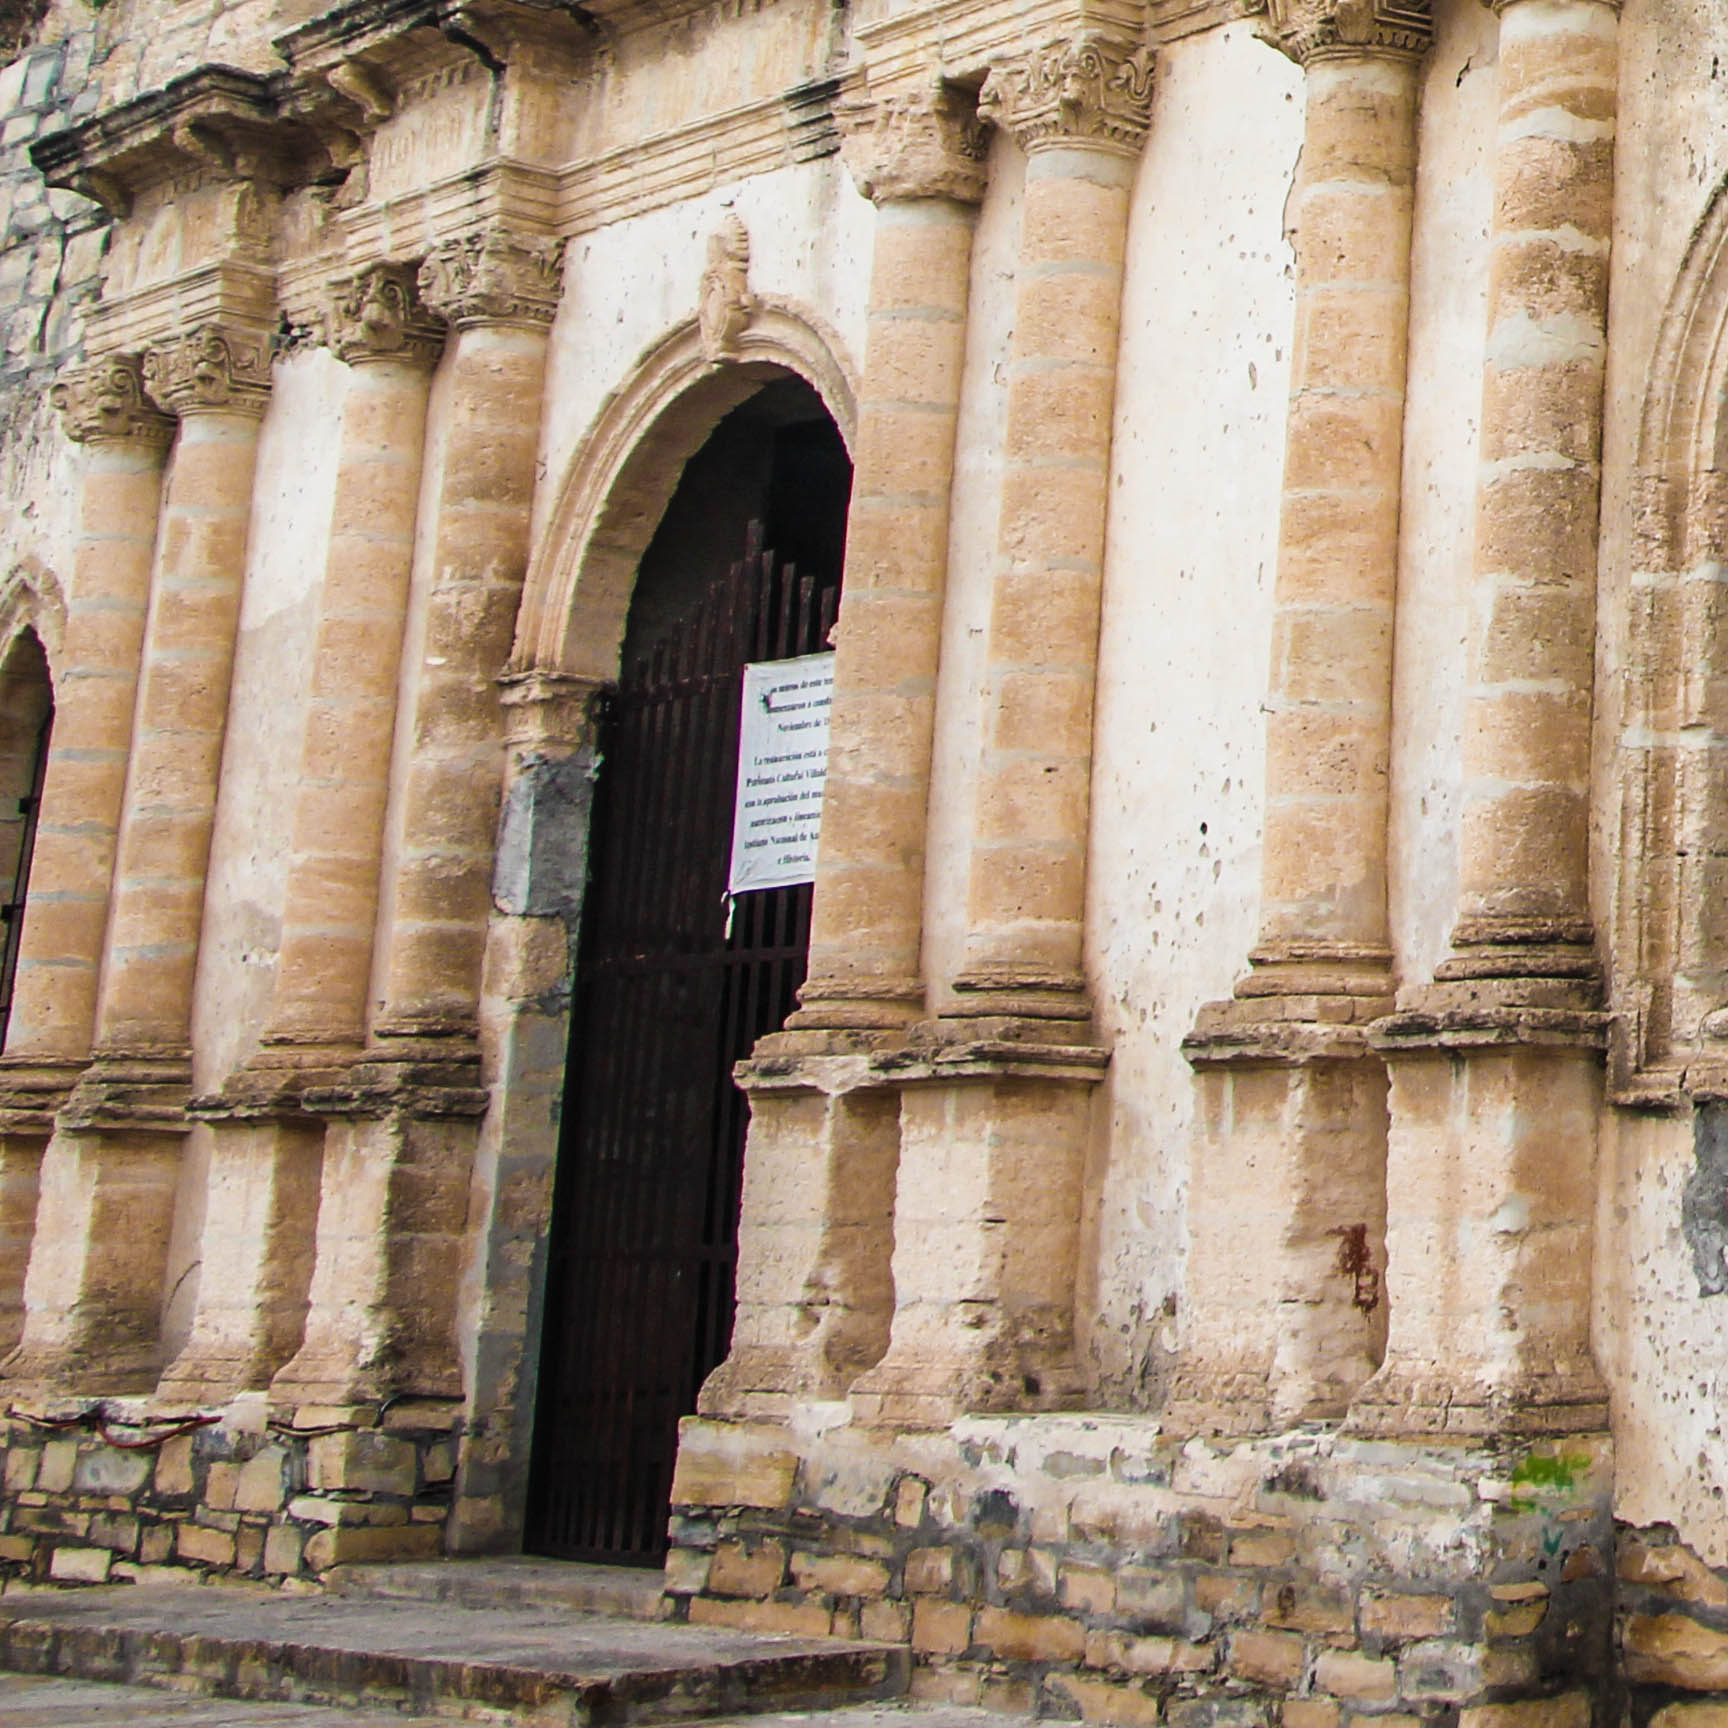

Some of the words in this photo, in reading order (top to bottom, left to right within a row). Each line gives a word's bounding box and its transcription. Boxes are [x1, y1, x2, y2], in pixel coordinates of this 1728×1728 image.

[800, 680, 808, 688] de
[814, 718, 821, 727] de
[800, 790, 810, 800] del
[771, 832, 798, 845] Nacional
[800, 831, 807, 841] de
